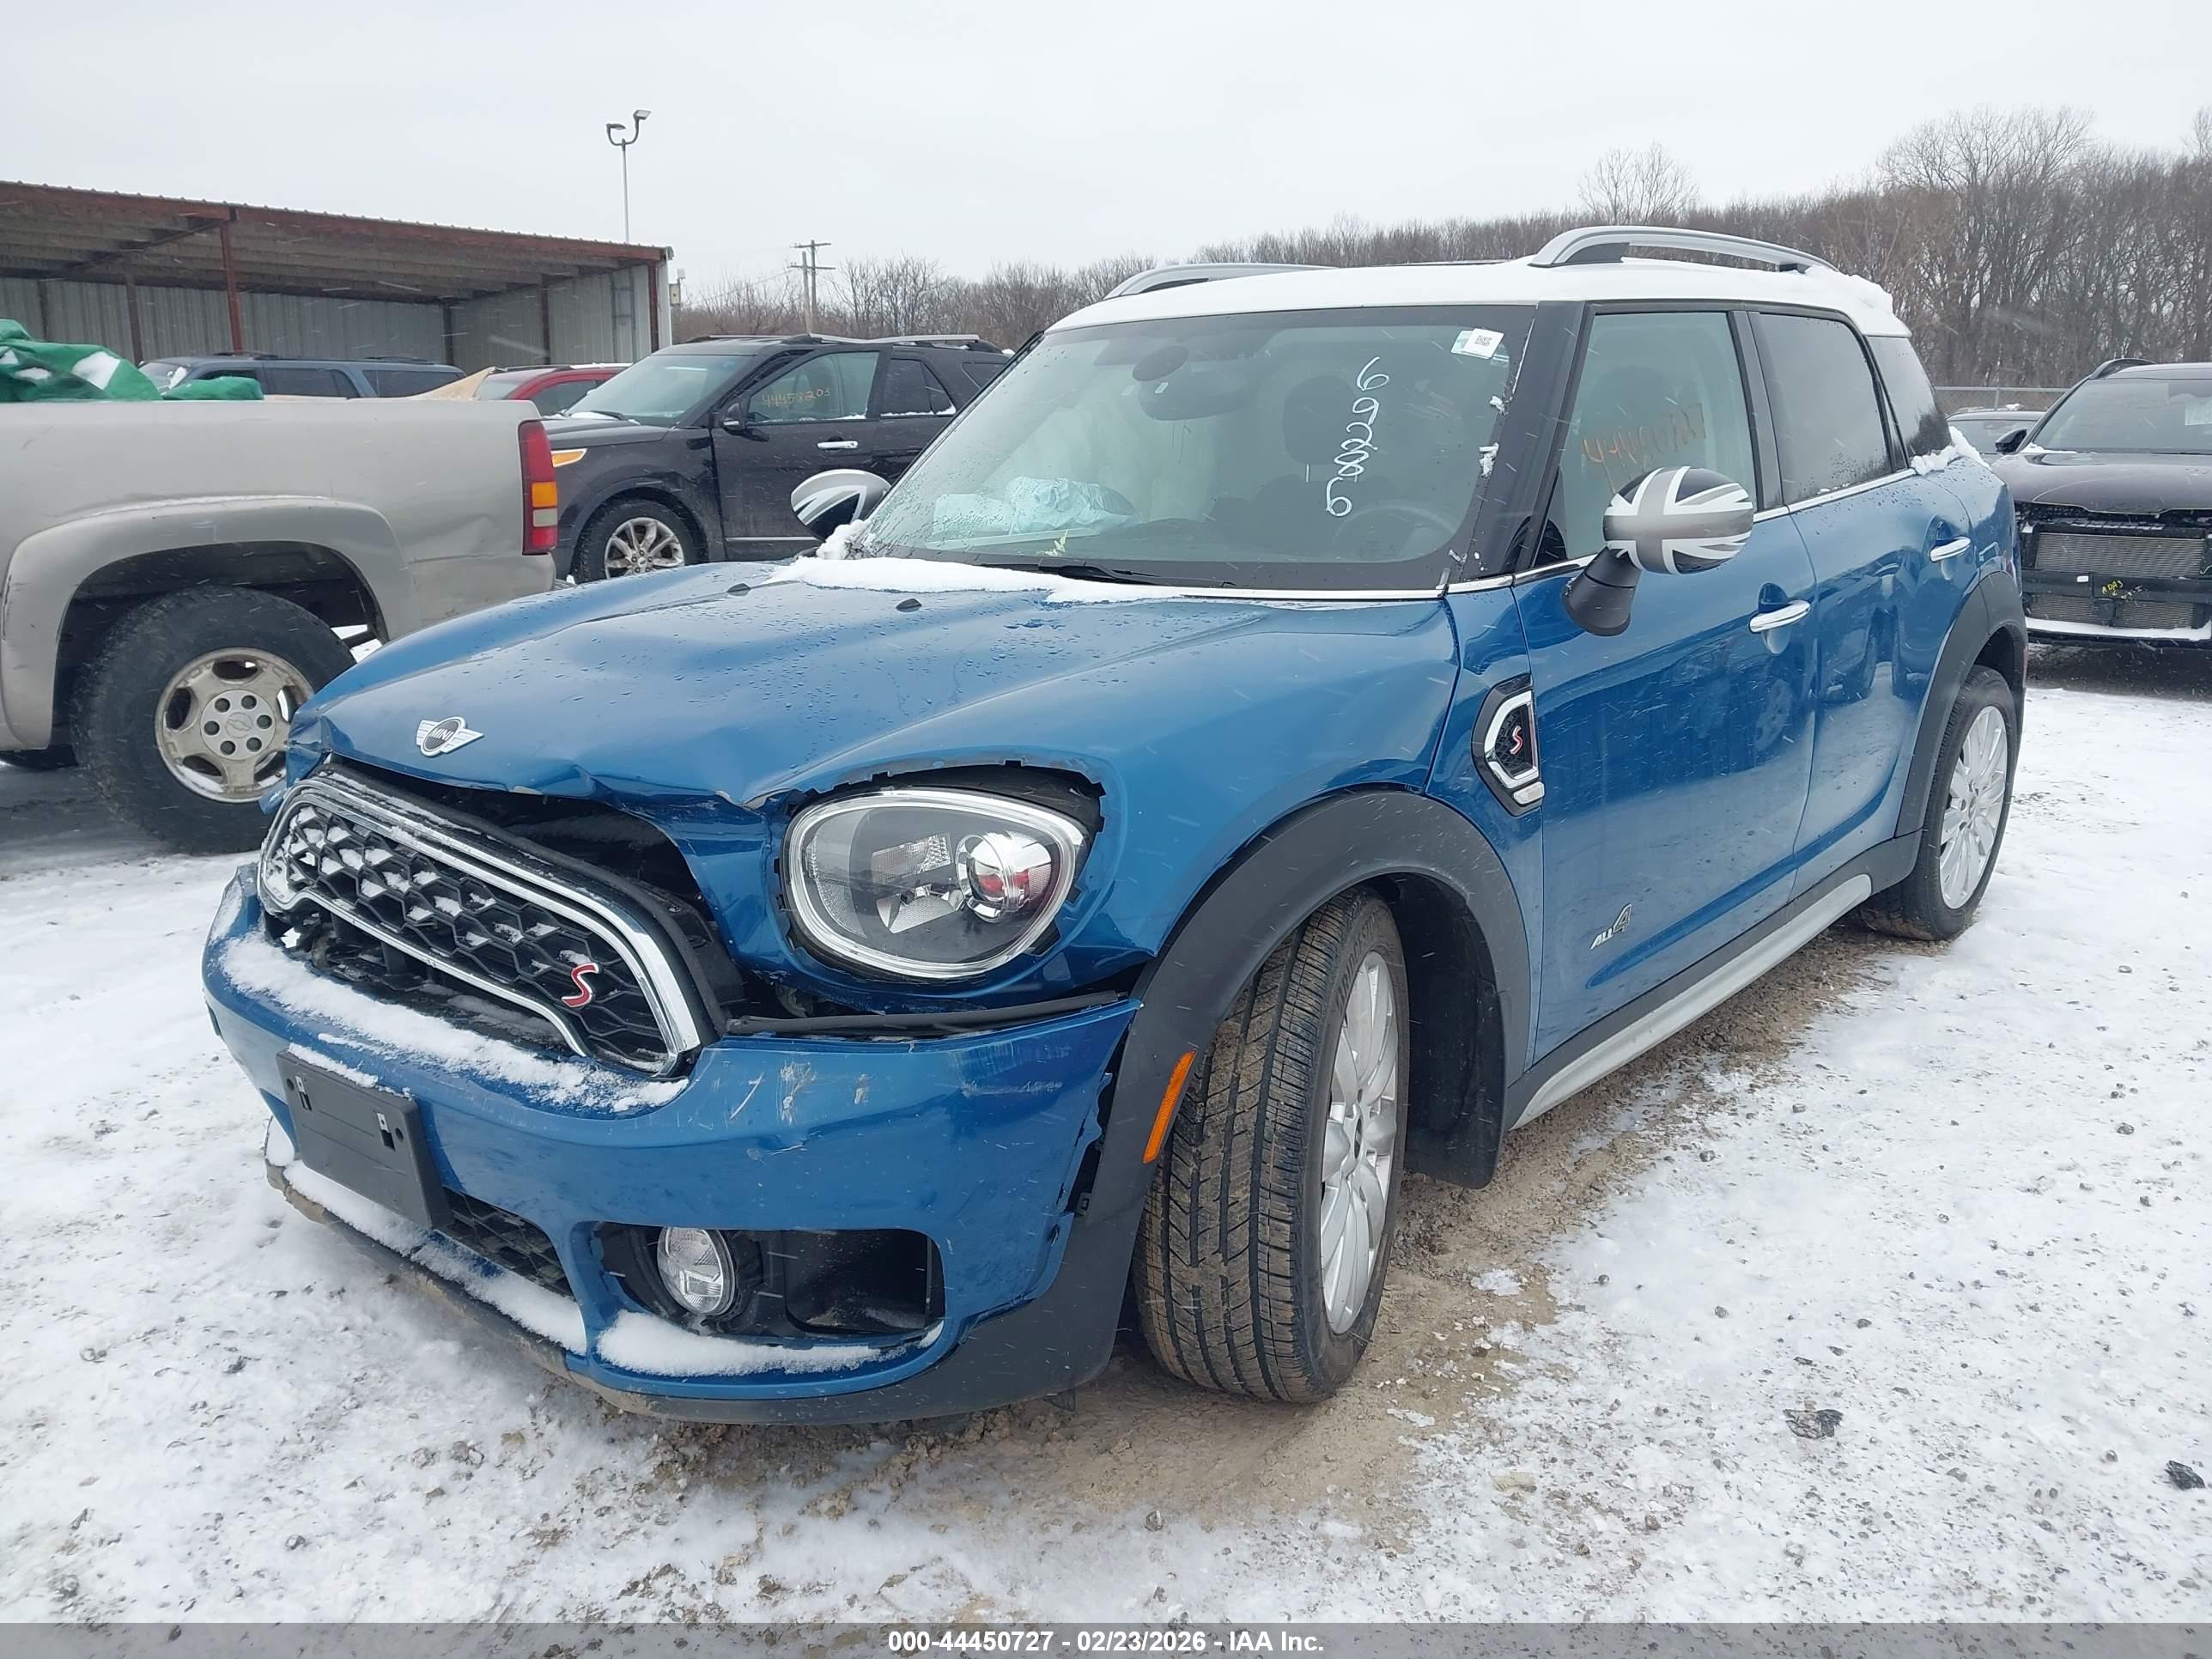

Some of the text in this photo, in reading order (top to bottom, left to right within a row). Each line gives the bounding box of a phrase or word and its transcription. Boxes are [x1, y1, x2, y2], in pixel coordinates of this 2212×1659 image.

[1326, 356, 1389, 517] 69286
[428, 727, 454, 742] MINI
[1510, 725, 1523, 755] S
[561, 963, 599, 1008] S
